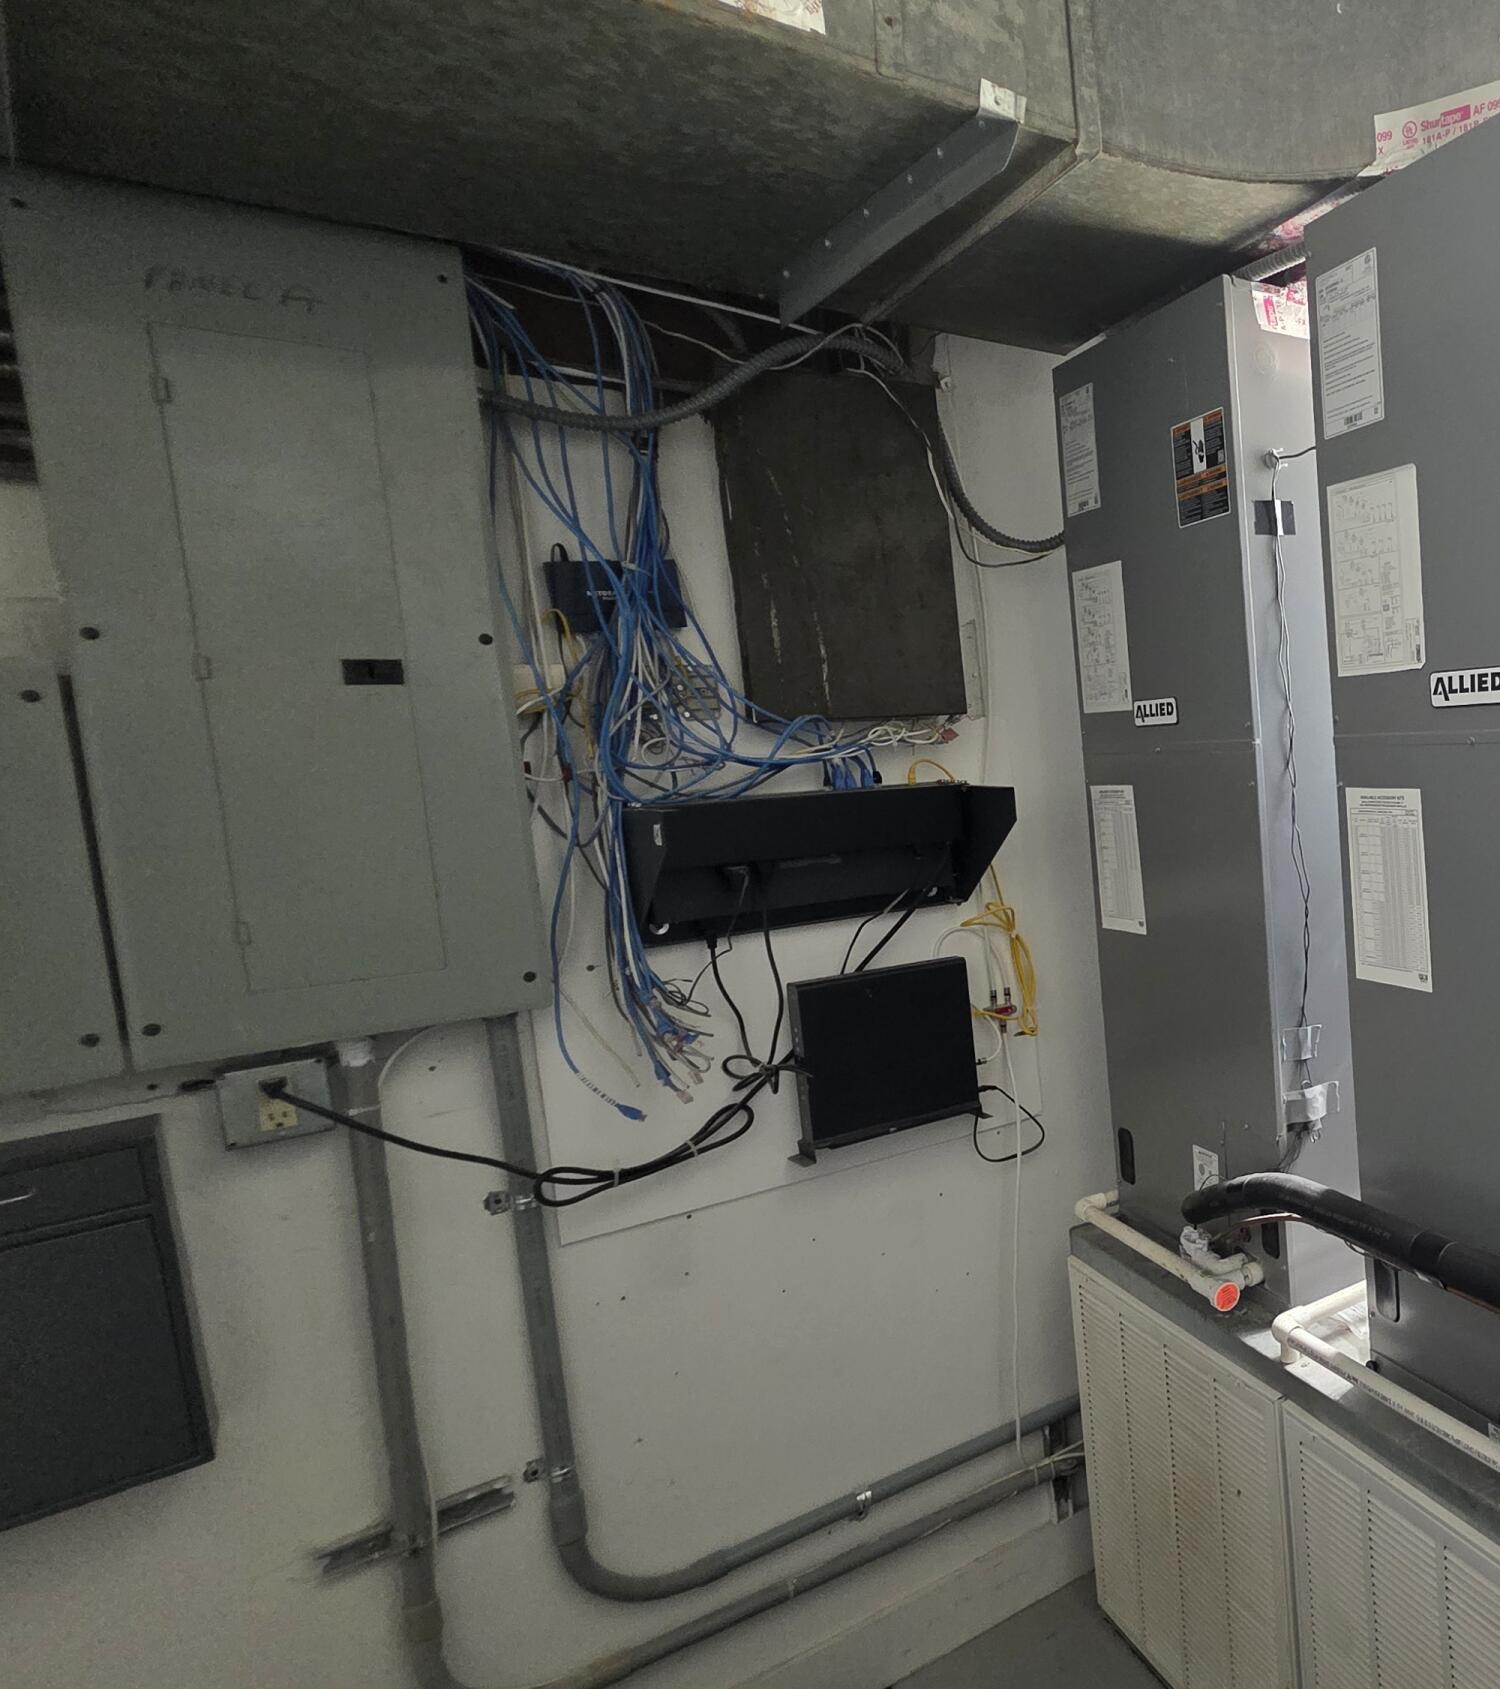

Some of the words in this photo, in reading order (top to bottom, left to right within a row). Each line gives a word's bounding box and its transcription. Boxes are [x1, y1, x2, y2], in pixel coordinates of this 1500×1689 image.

[1420, 110, 1464, 132] Shurtape
[1473, 102, 1486, 116] AF
[1376, 130, 1393, 142] 099
[1136, 702, 1174, 723] ALLIED
